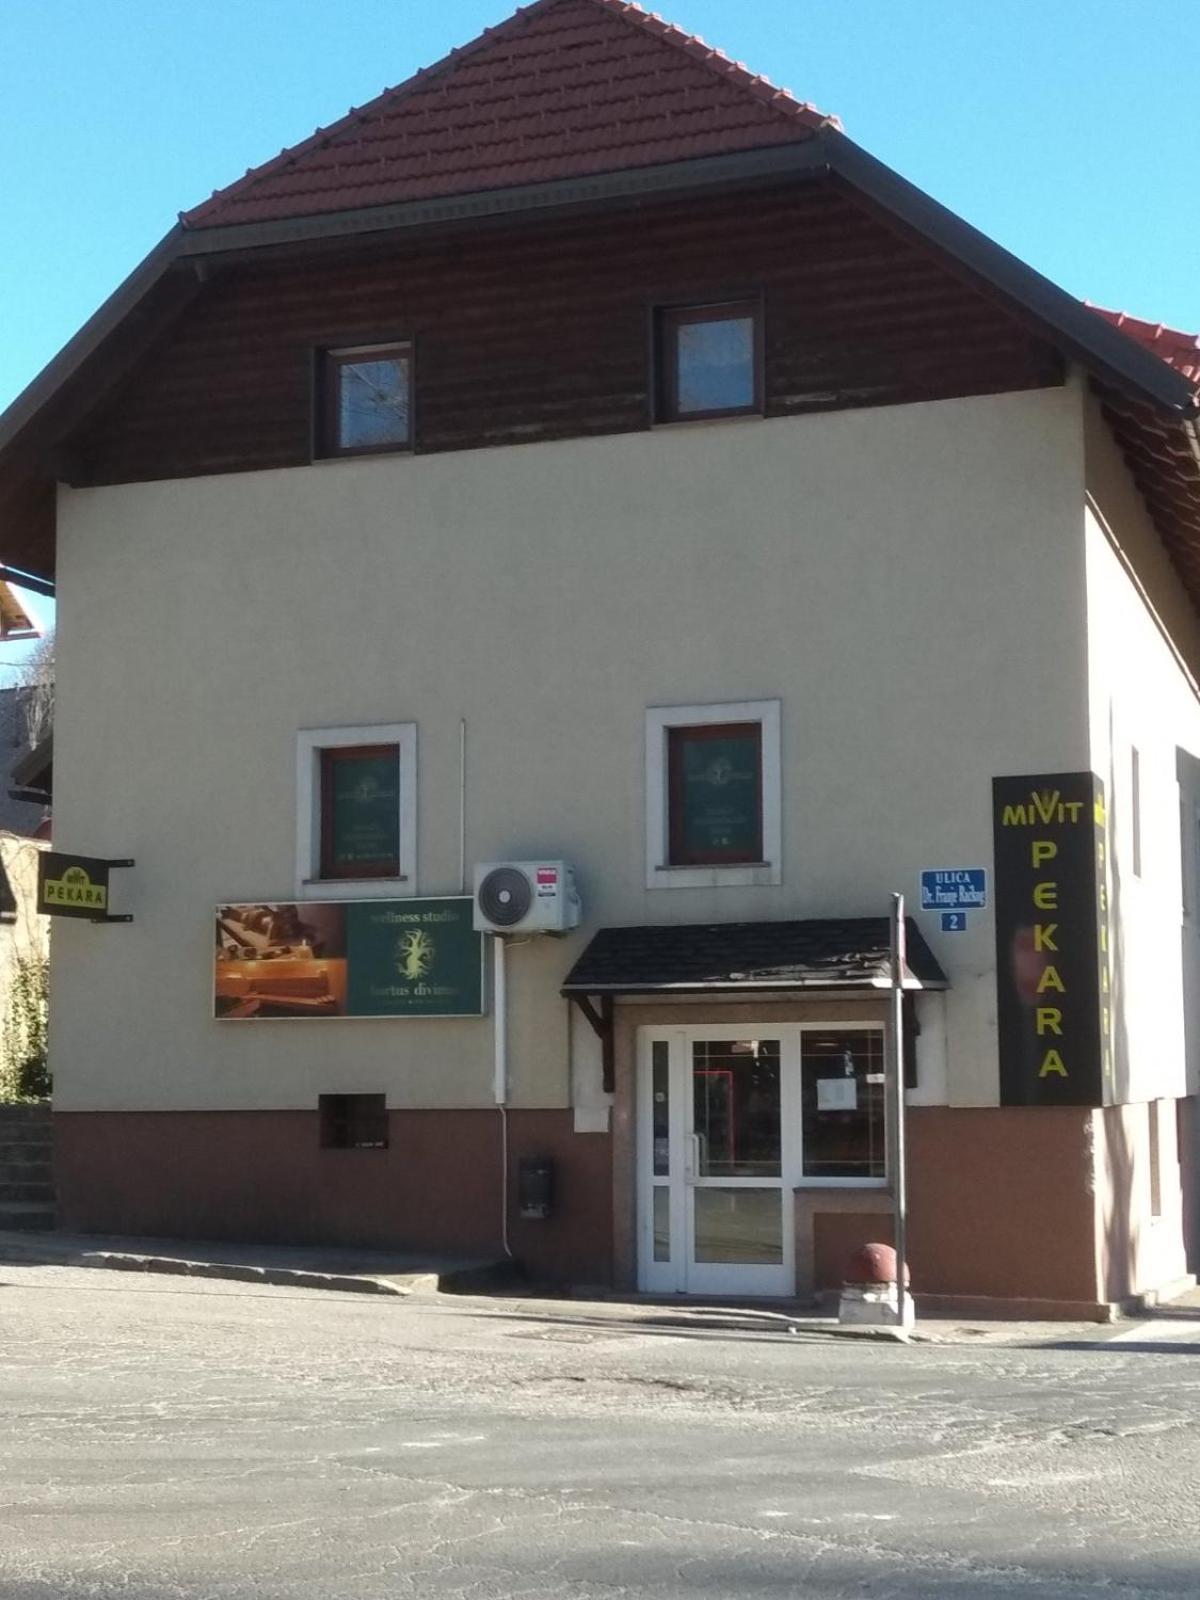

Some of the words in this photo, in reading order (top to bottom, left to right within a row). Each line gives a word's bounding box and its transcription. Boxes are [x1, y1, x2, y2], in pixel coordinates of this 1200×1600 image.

[935, 872, 971, 884] ULICA
[47, 885, 103, 904] PEKARA
[949, 914, 958, 929] 2
[1031, 841, 1069, 1078] PEKARA
